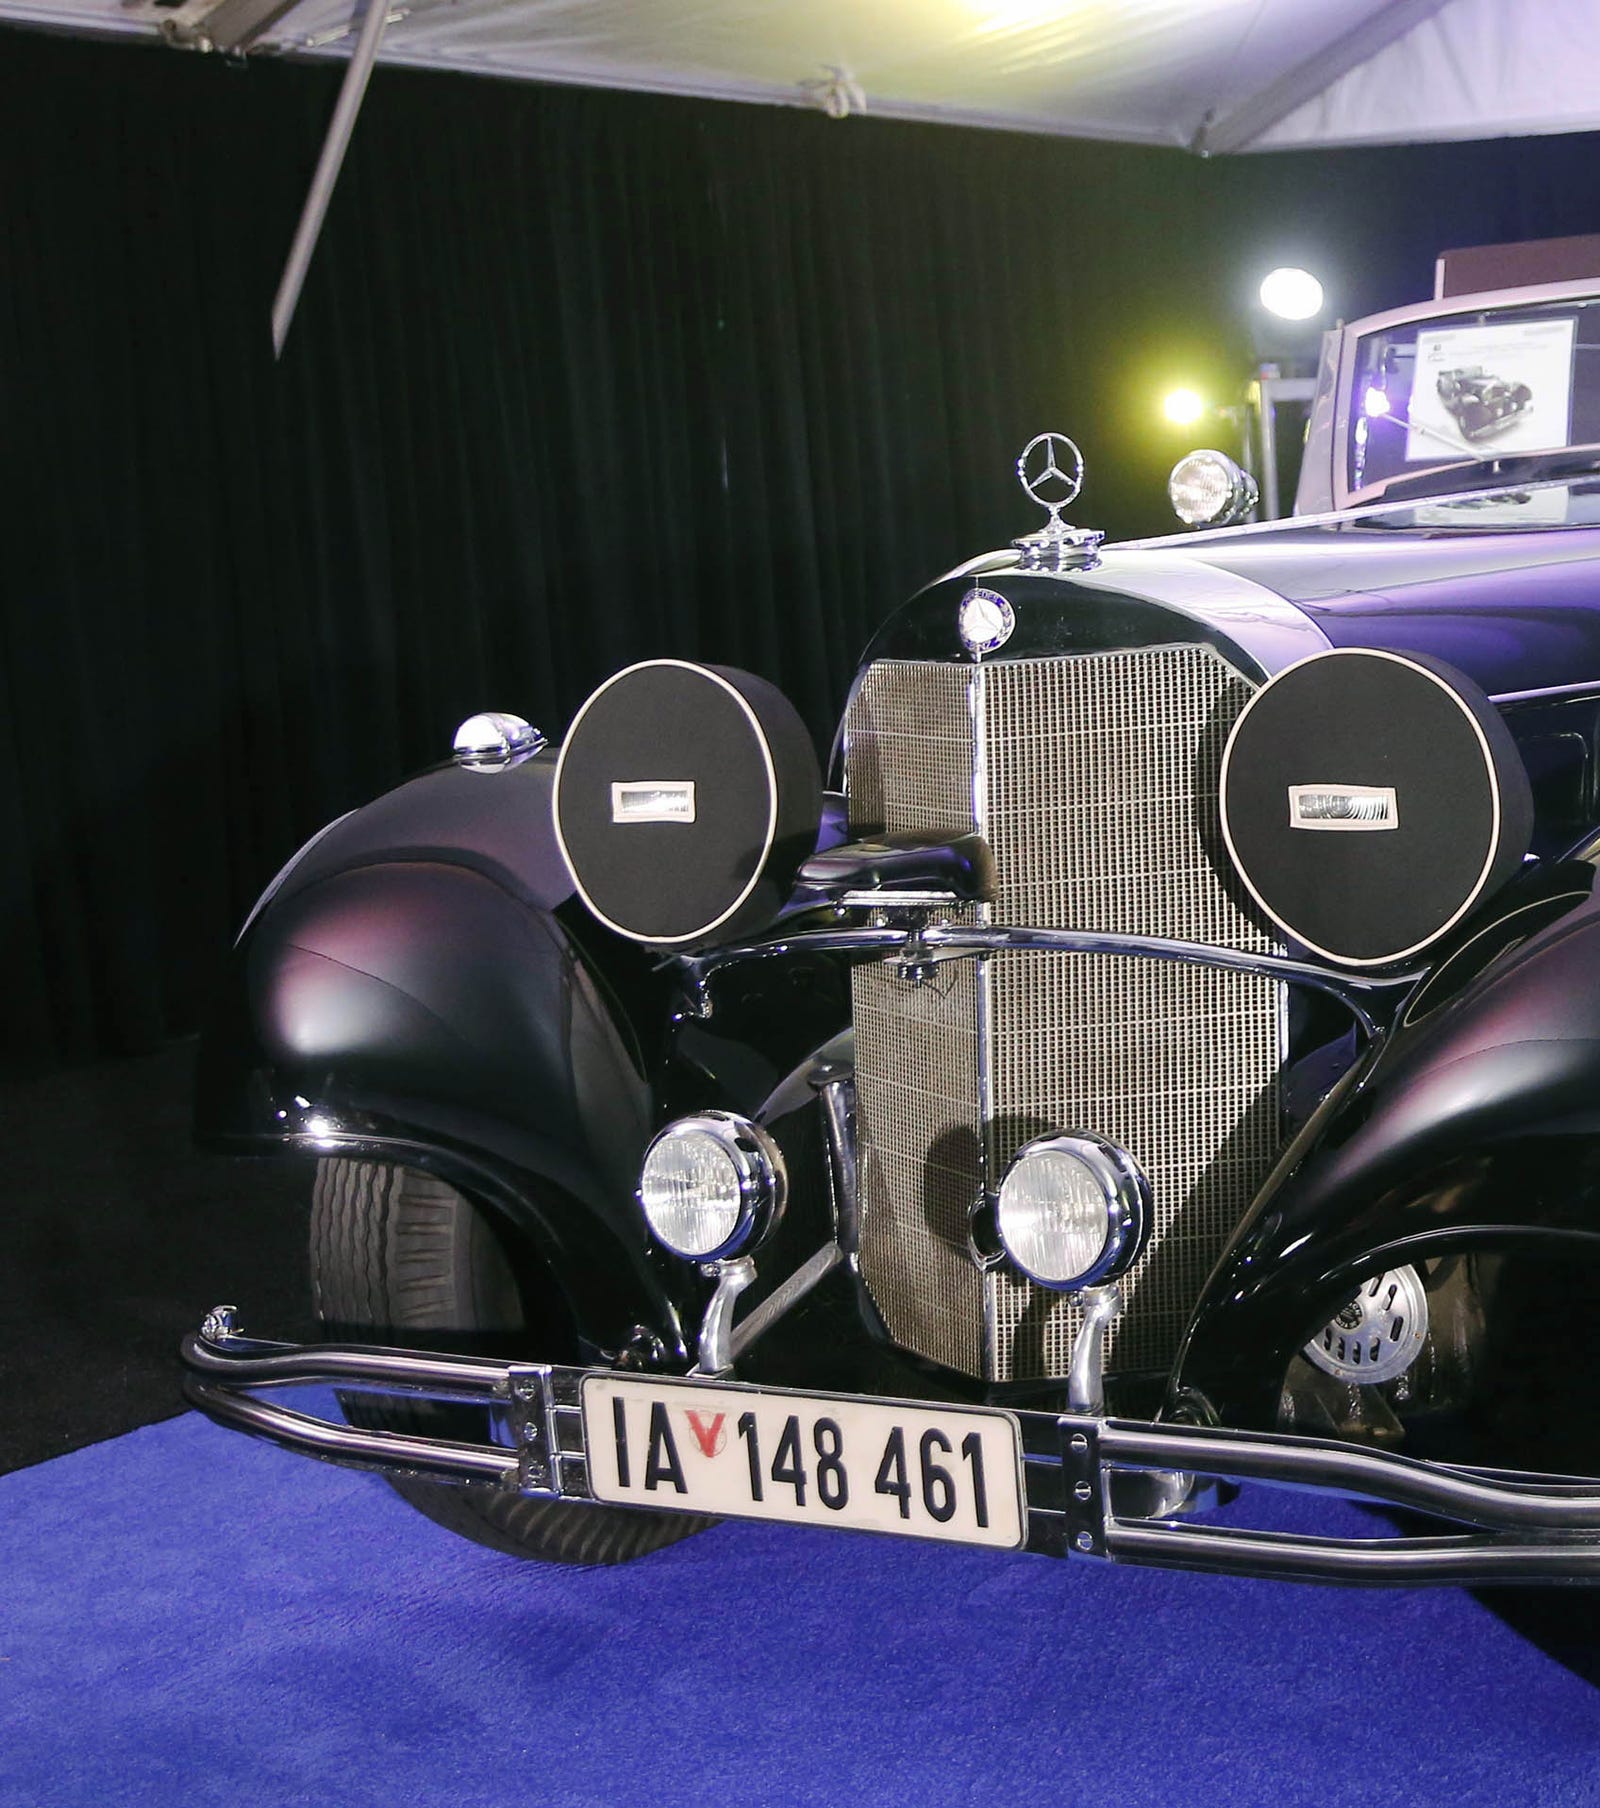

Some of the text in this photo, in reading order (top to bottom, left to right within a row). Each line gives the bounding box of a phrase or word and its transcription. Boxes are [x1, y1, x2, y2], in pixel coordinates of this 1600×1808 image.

[612, 1396, 688, 1495] IA
[738, 1411, 849, 1511] 148
[874, 1426, 989, 1529] 461
